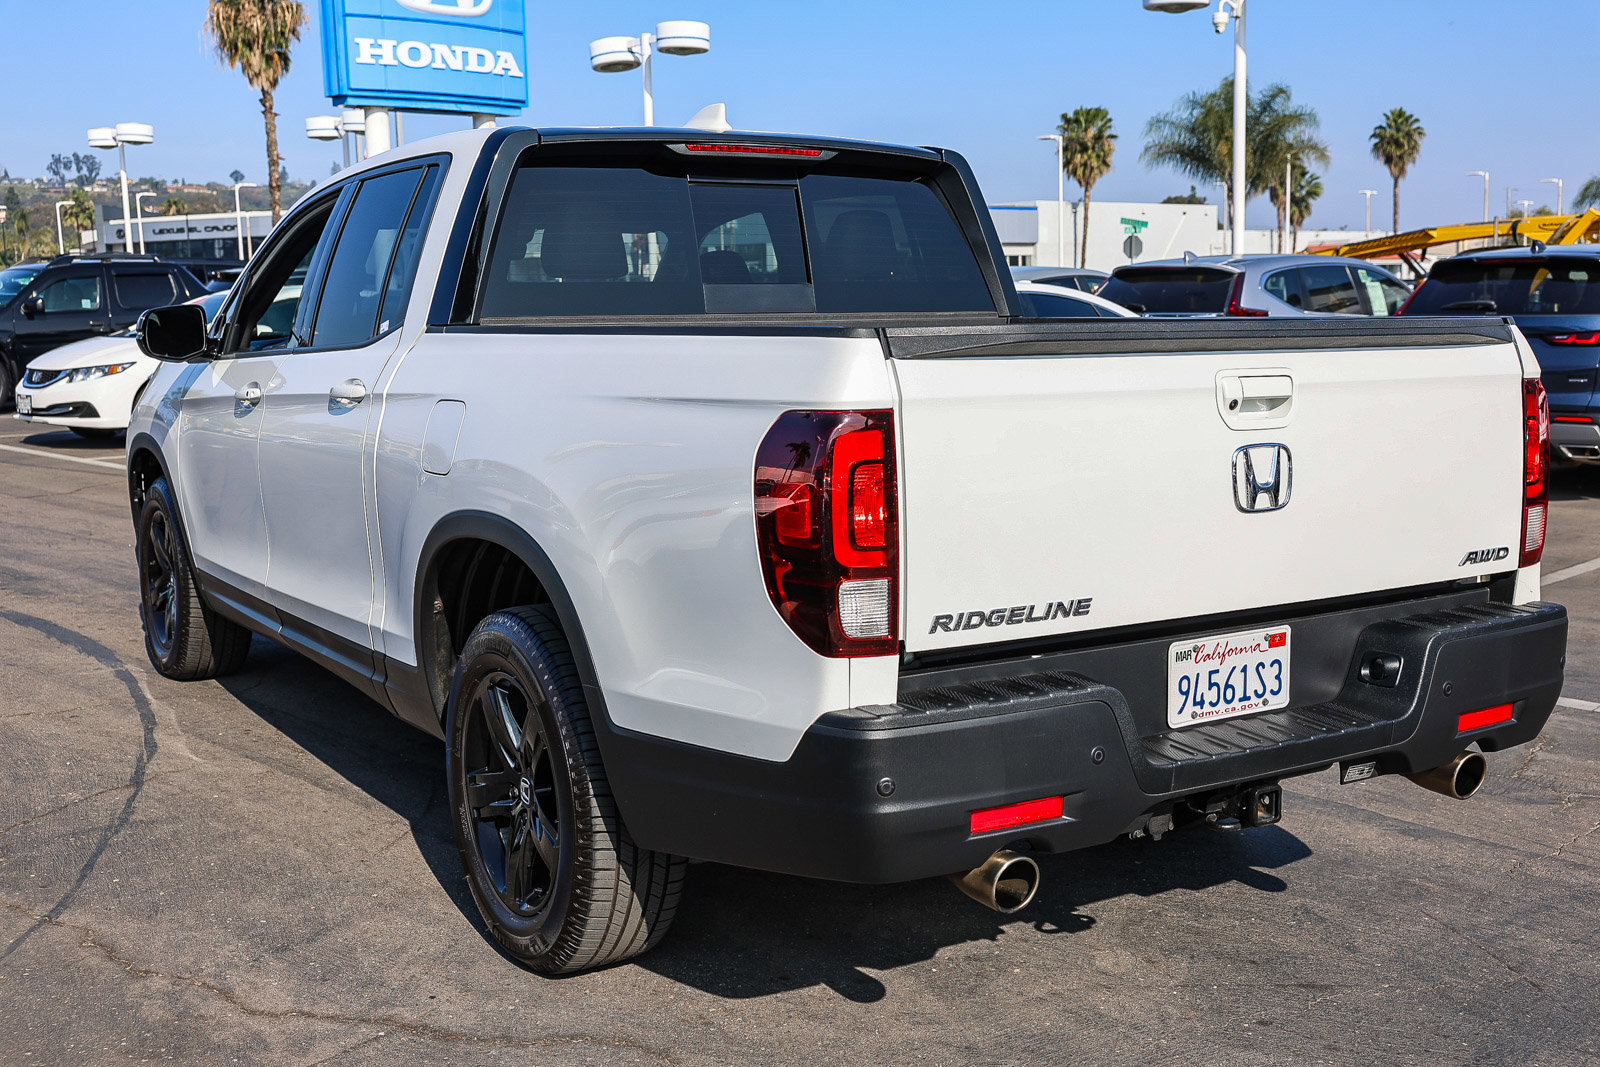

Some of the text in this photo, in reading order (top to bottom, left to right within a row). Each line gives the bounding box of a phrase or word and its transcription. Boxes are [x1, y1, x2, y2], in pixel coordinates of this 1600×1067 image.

[354, 37, 524, 78] HONDA
[152, 227, 185, 235] LEXUS
[1458, 546, 1509, 567] AWD
[928, 597, 1093, 635] RIDGELINE
[1175, 649, 1192, 662] MAR
[1194, 637, 1269, 666] California
[1177, 658, 1283, 715] 94561S3
[1198, 701, 1260, 718] dmv.ca.gov
